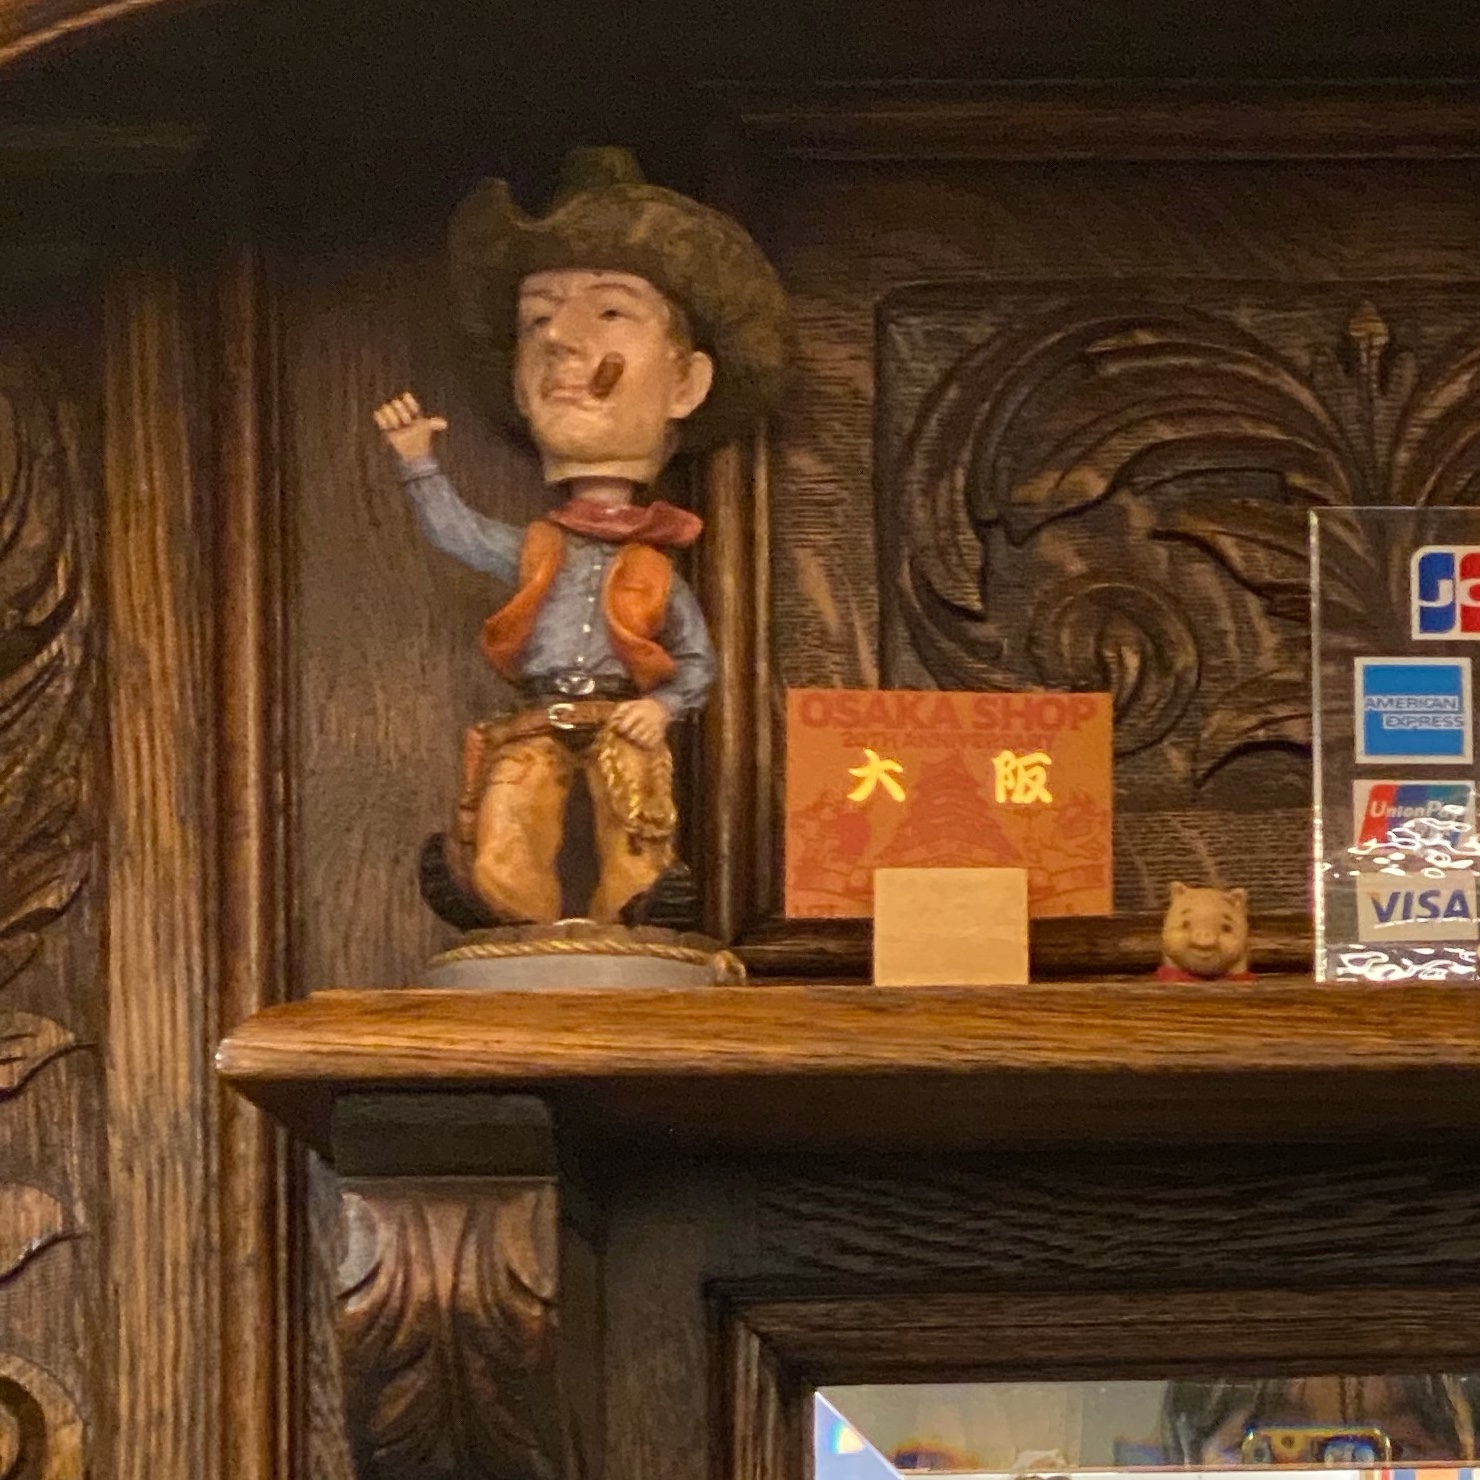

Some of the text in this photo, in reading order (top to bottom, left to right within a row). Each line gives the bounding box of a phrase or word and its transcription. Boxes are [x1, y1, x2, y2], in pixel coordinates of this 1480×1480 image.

[800, 692, 1099, 732] OSAKA SHOP
[1365, 696, 1458, 712] AMERICAN
[1385, 714, 1464, 729] EXPRESS
[1368, 889, 1471, 924] VISA
